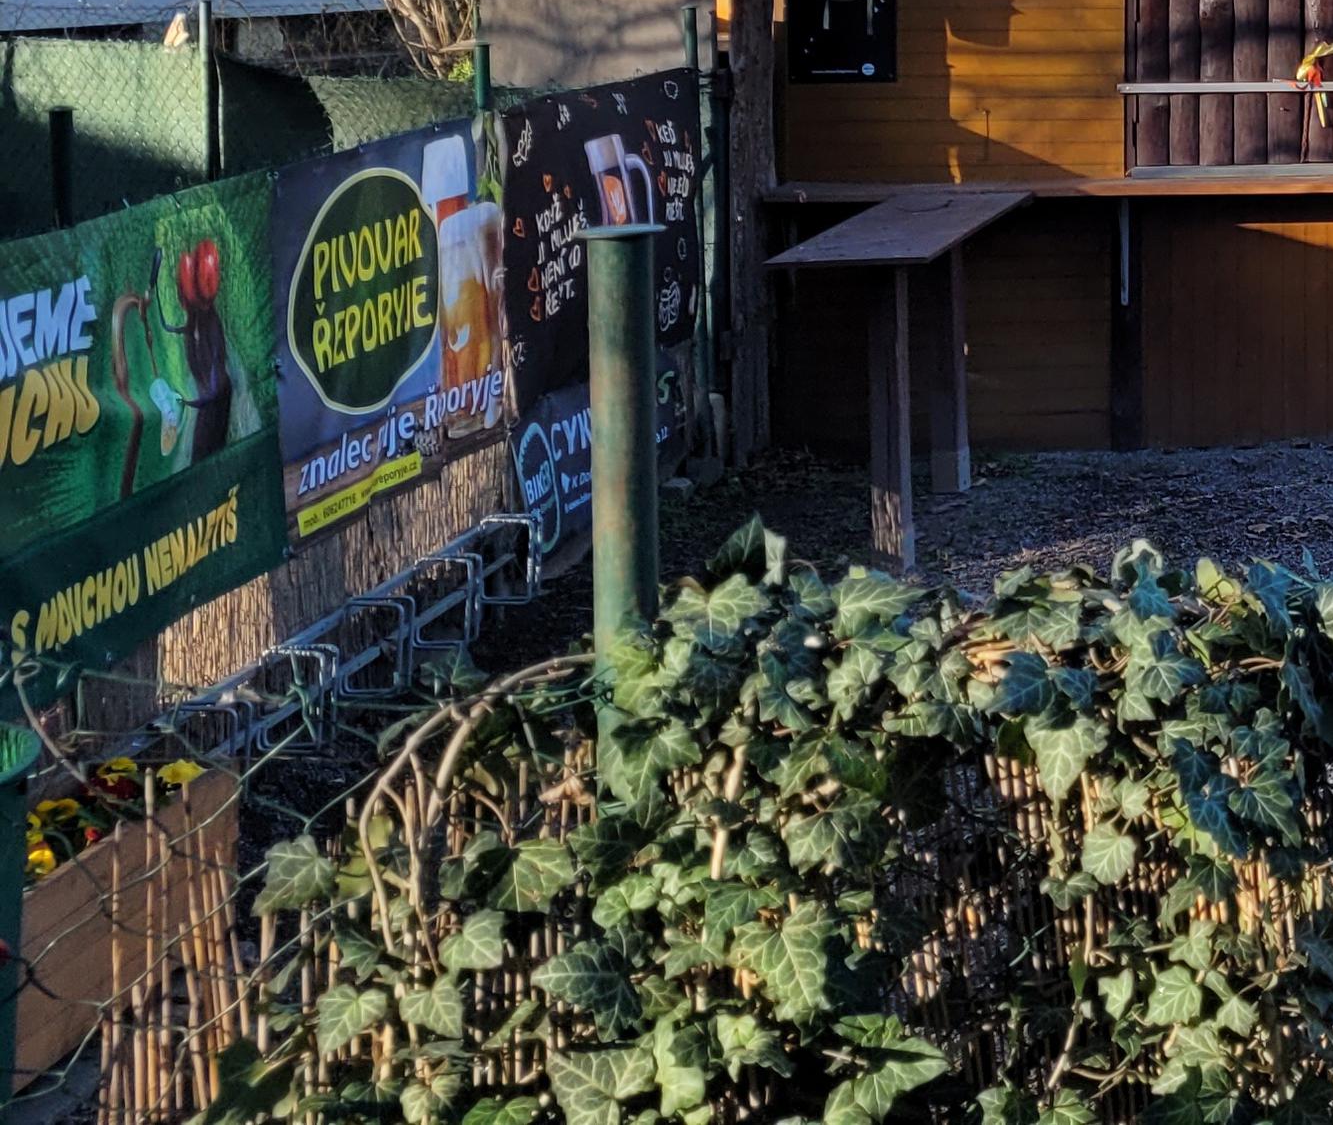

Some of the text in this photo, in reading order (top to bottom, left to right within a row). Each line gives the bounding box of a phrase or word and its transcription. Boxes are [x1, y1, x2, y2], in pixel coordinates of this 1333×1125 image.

[313, 208, 423, 300] PIVOVAR
[312, 275, 434, 374] ŘEPORYJE
[297, 432, 373, 496] znalec
[34, 553, 141, 656] MOUCHOU
